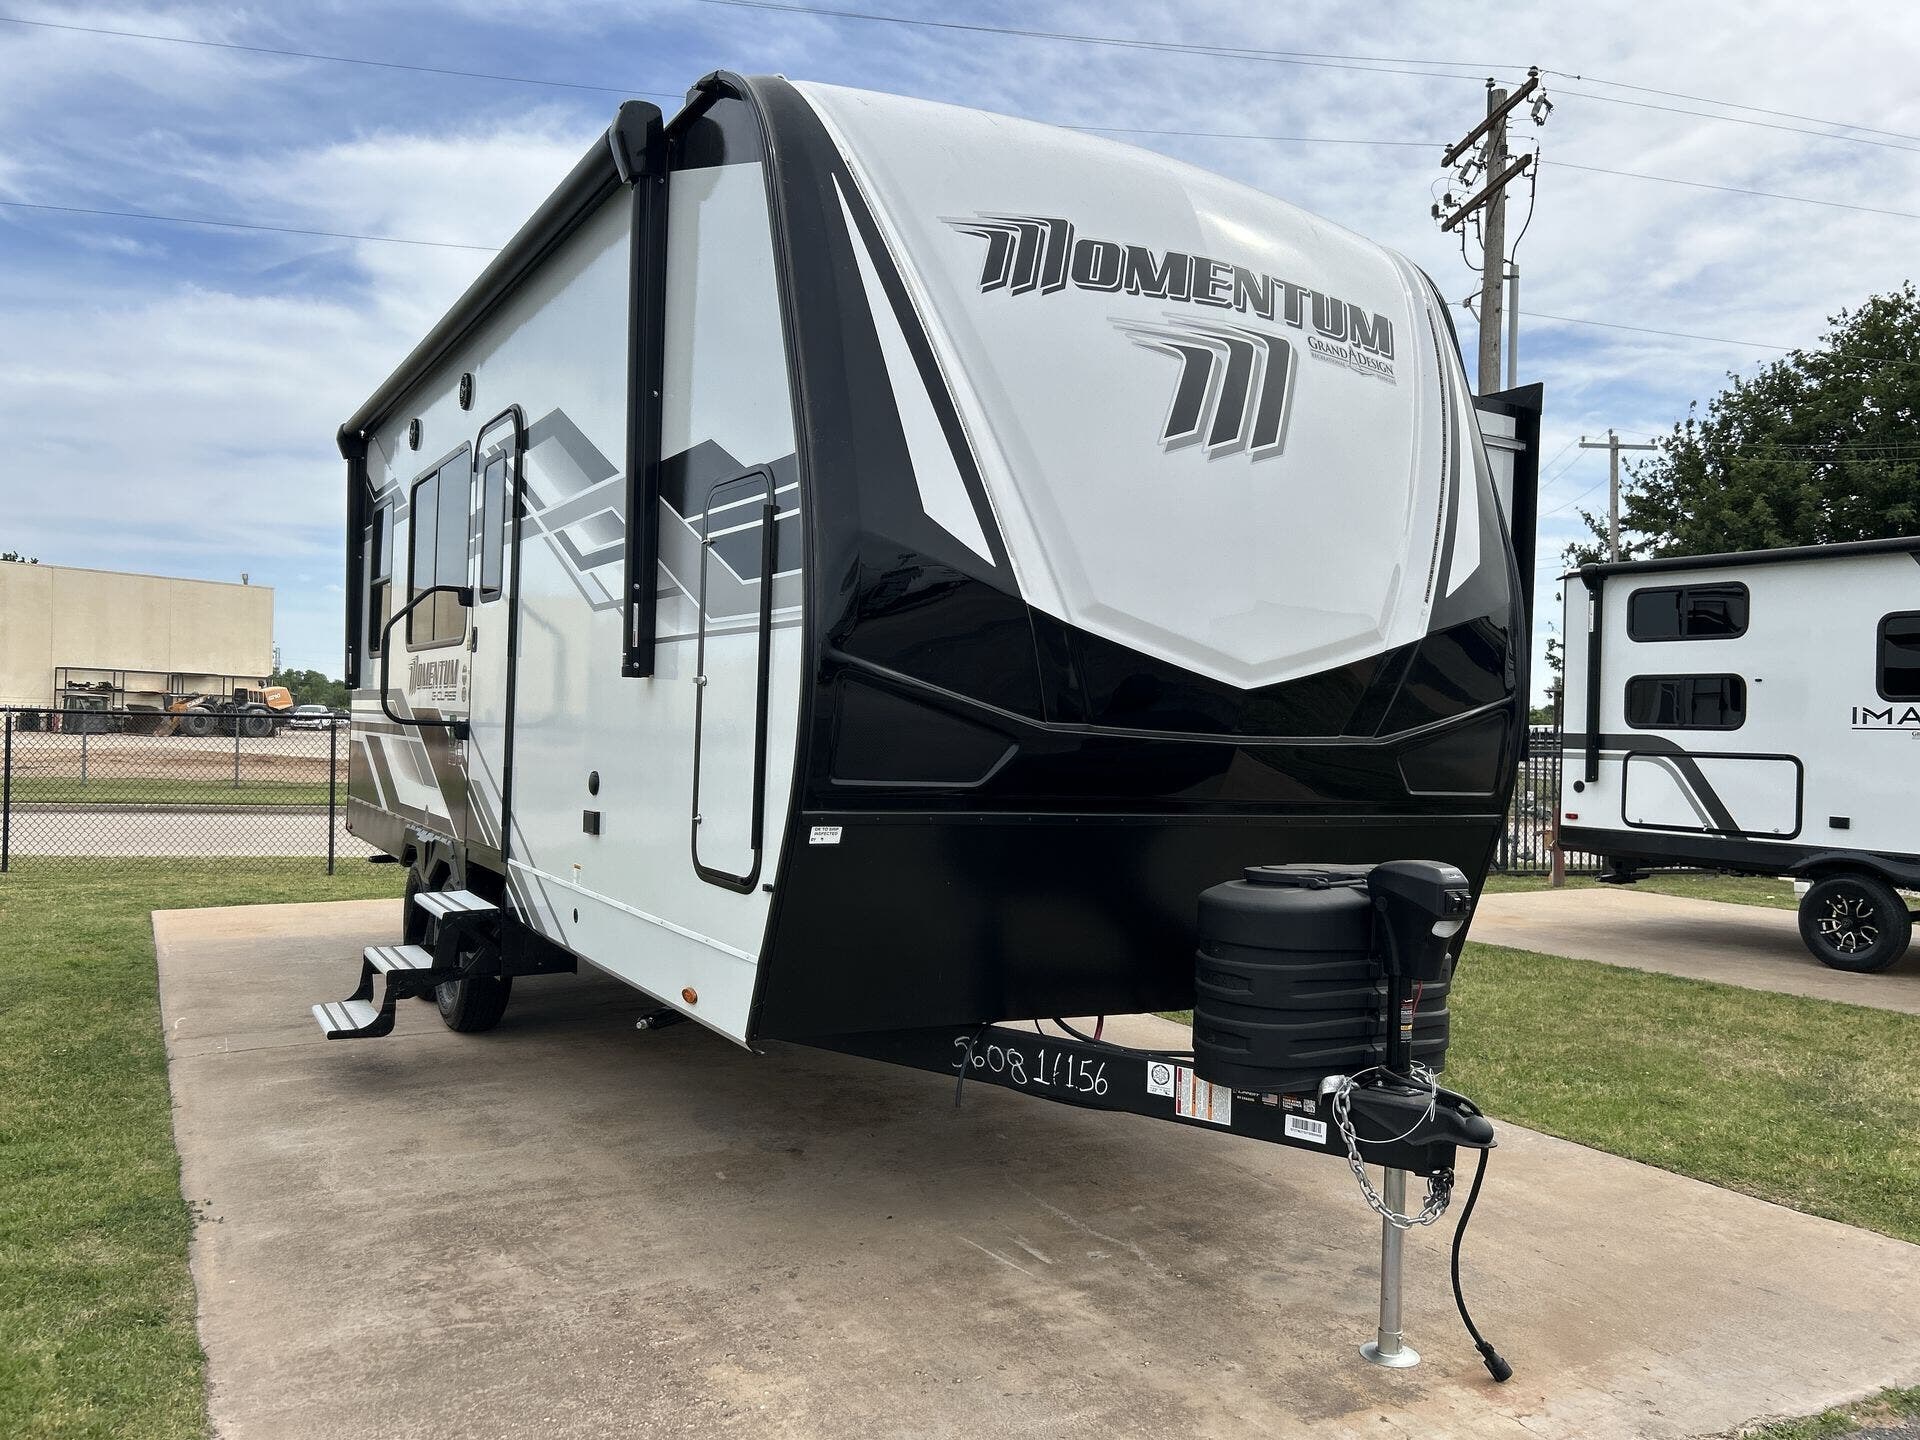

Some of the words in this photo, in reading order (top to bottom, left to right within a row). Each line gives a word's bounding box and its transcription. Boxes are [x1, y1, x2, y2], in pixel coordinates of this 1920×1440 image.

[937, 211, 1395, 361] MOMENTUM
[1307, 336, 1348, 359] GRAND
[1357, 351, 1395, 376] DESIGN
[408, 655, 460, 696] MOMENTUM
